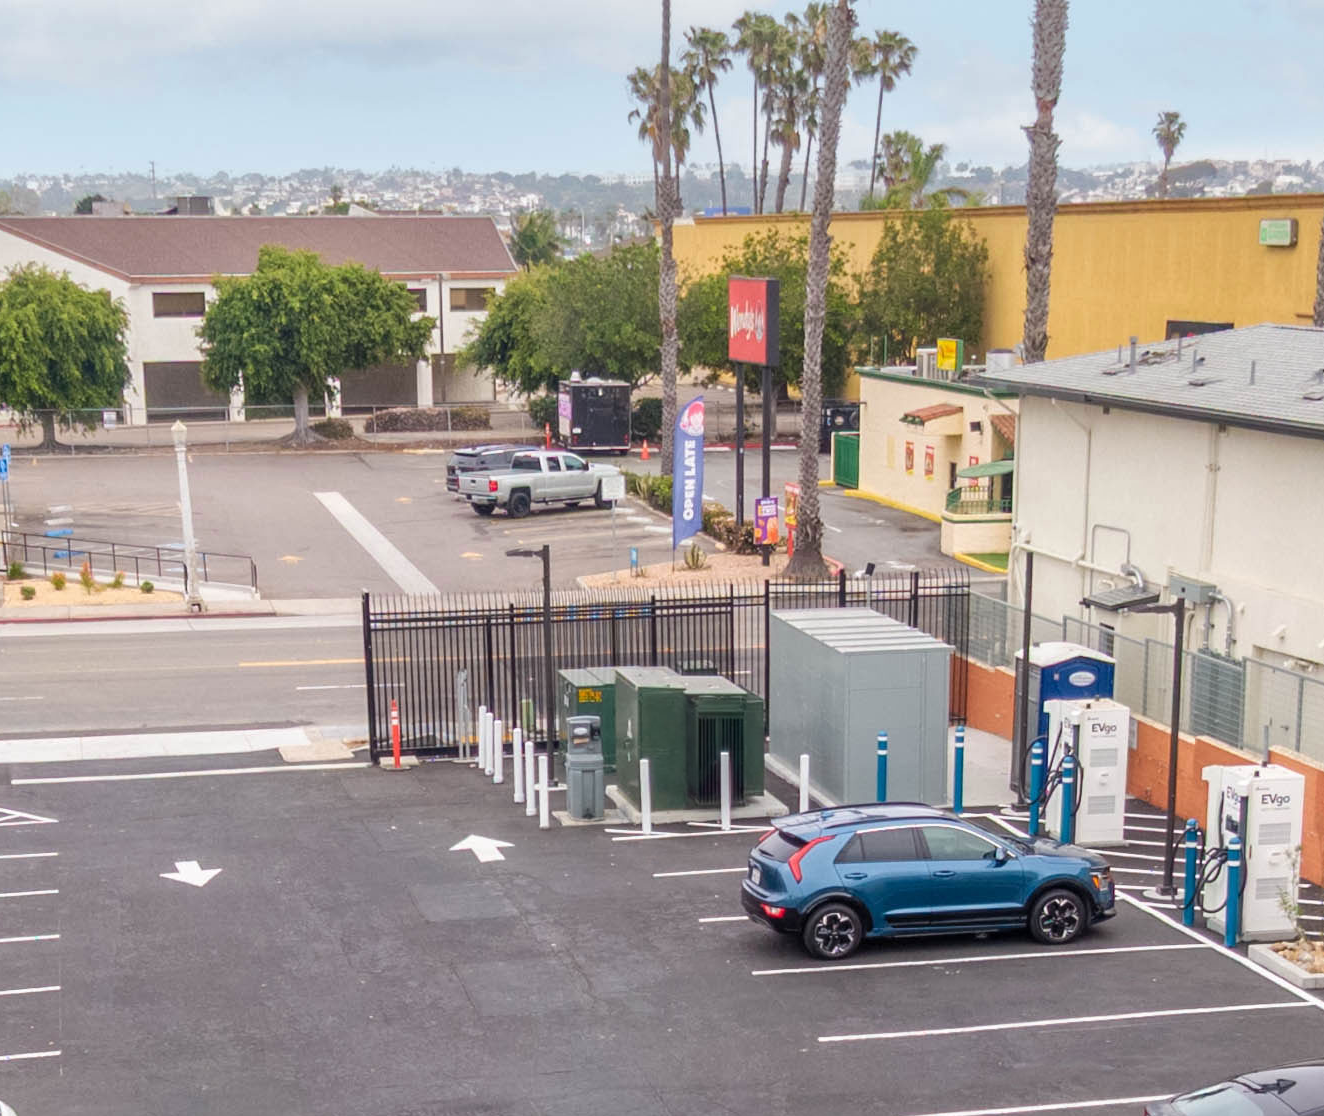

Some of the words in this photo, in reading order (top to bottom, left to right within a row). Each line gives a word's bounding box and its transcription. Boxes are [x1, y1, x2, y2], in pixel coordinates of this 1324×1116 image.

[685, 440, 696, 476] LATE
[683, 479, 695, 521] OPEN
[1091, 723, 1117, 735] EVgo
[1261, 793, 1290, 806] EVgo
